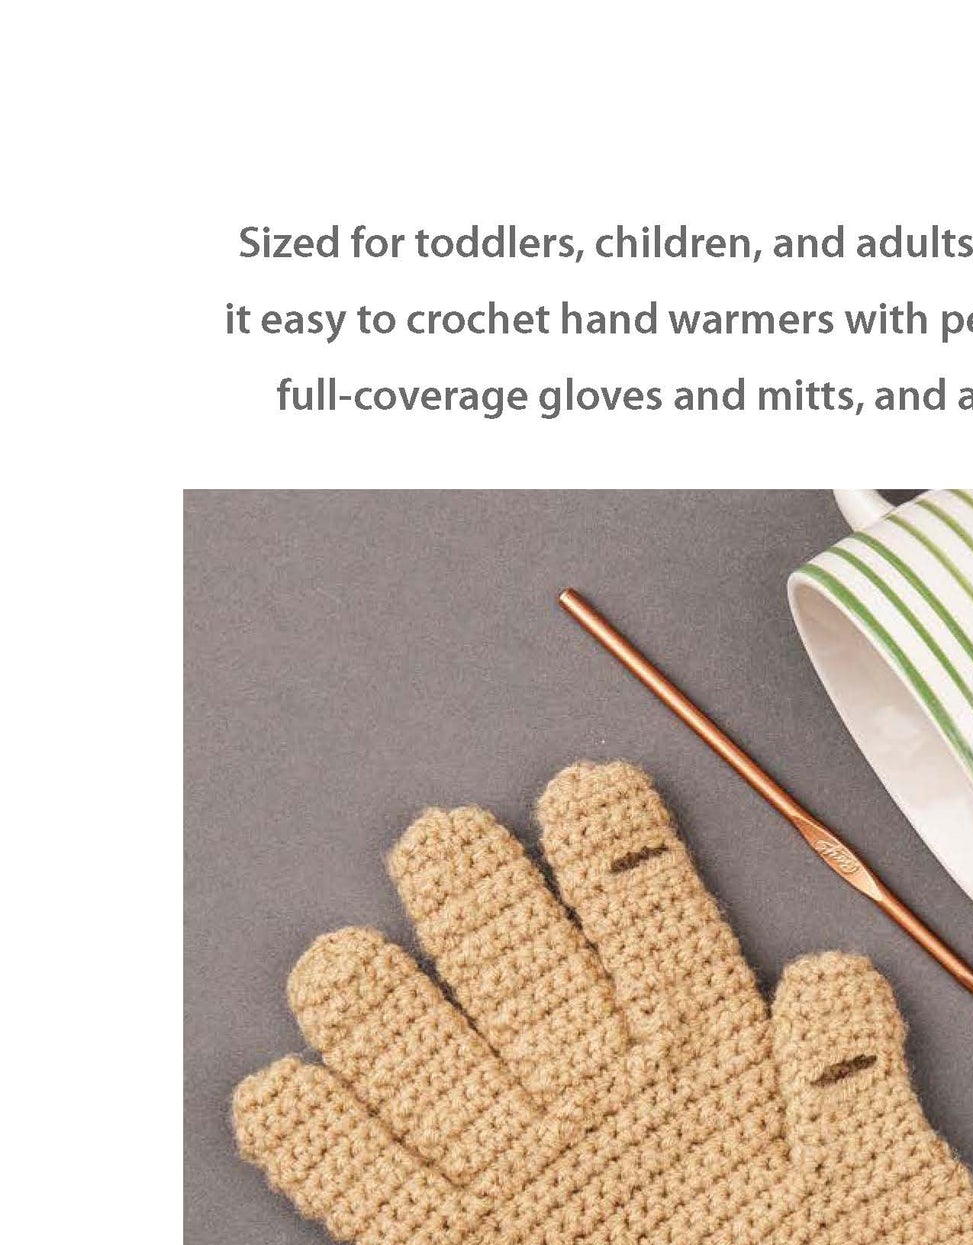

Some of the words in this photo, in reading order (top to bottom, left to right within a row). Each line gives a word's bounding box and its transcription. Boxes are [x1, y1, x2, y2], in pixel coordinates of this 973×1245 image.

[240, 225, 338, 257] Sized
[351, 225, 404, 257] for
[415, 225, 583, 262] toddlers,
[596, 225, 761, 262] children,
[774, 225, 843, 257] and
[227, 303, 250, 333] it
[262, 311, 346, 343] easy
[357, 306, 395, 333] to
[408, 302, 549, 333] crochet
[563, 301, 656, 333] hand
[669, 311, 833, 333] warmers
[845, 301, 926, 333] with
[277, 378, 527, 419] full-coverage
[540, 378, 662, 419] gloves
[675, 378, 744, 410] and
[759, 379, 863, 415] mitts,
[875, 378, 945, 410] and
